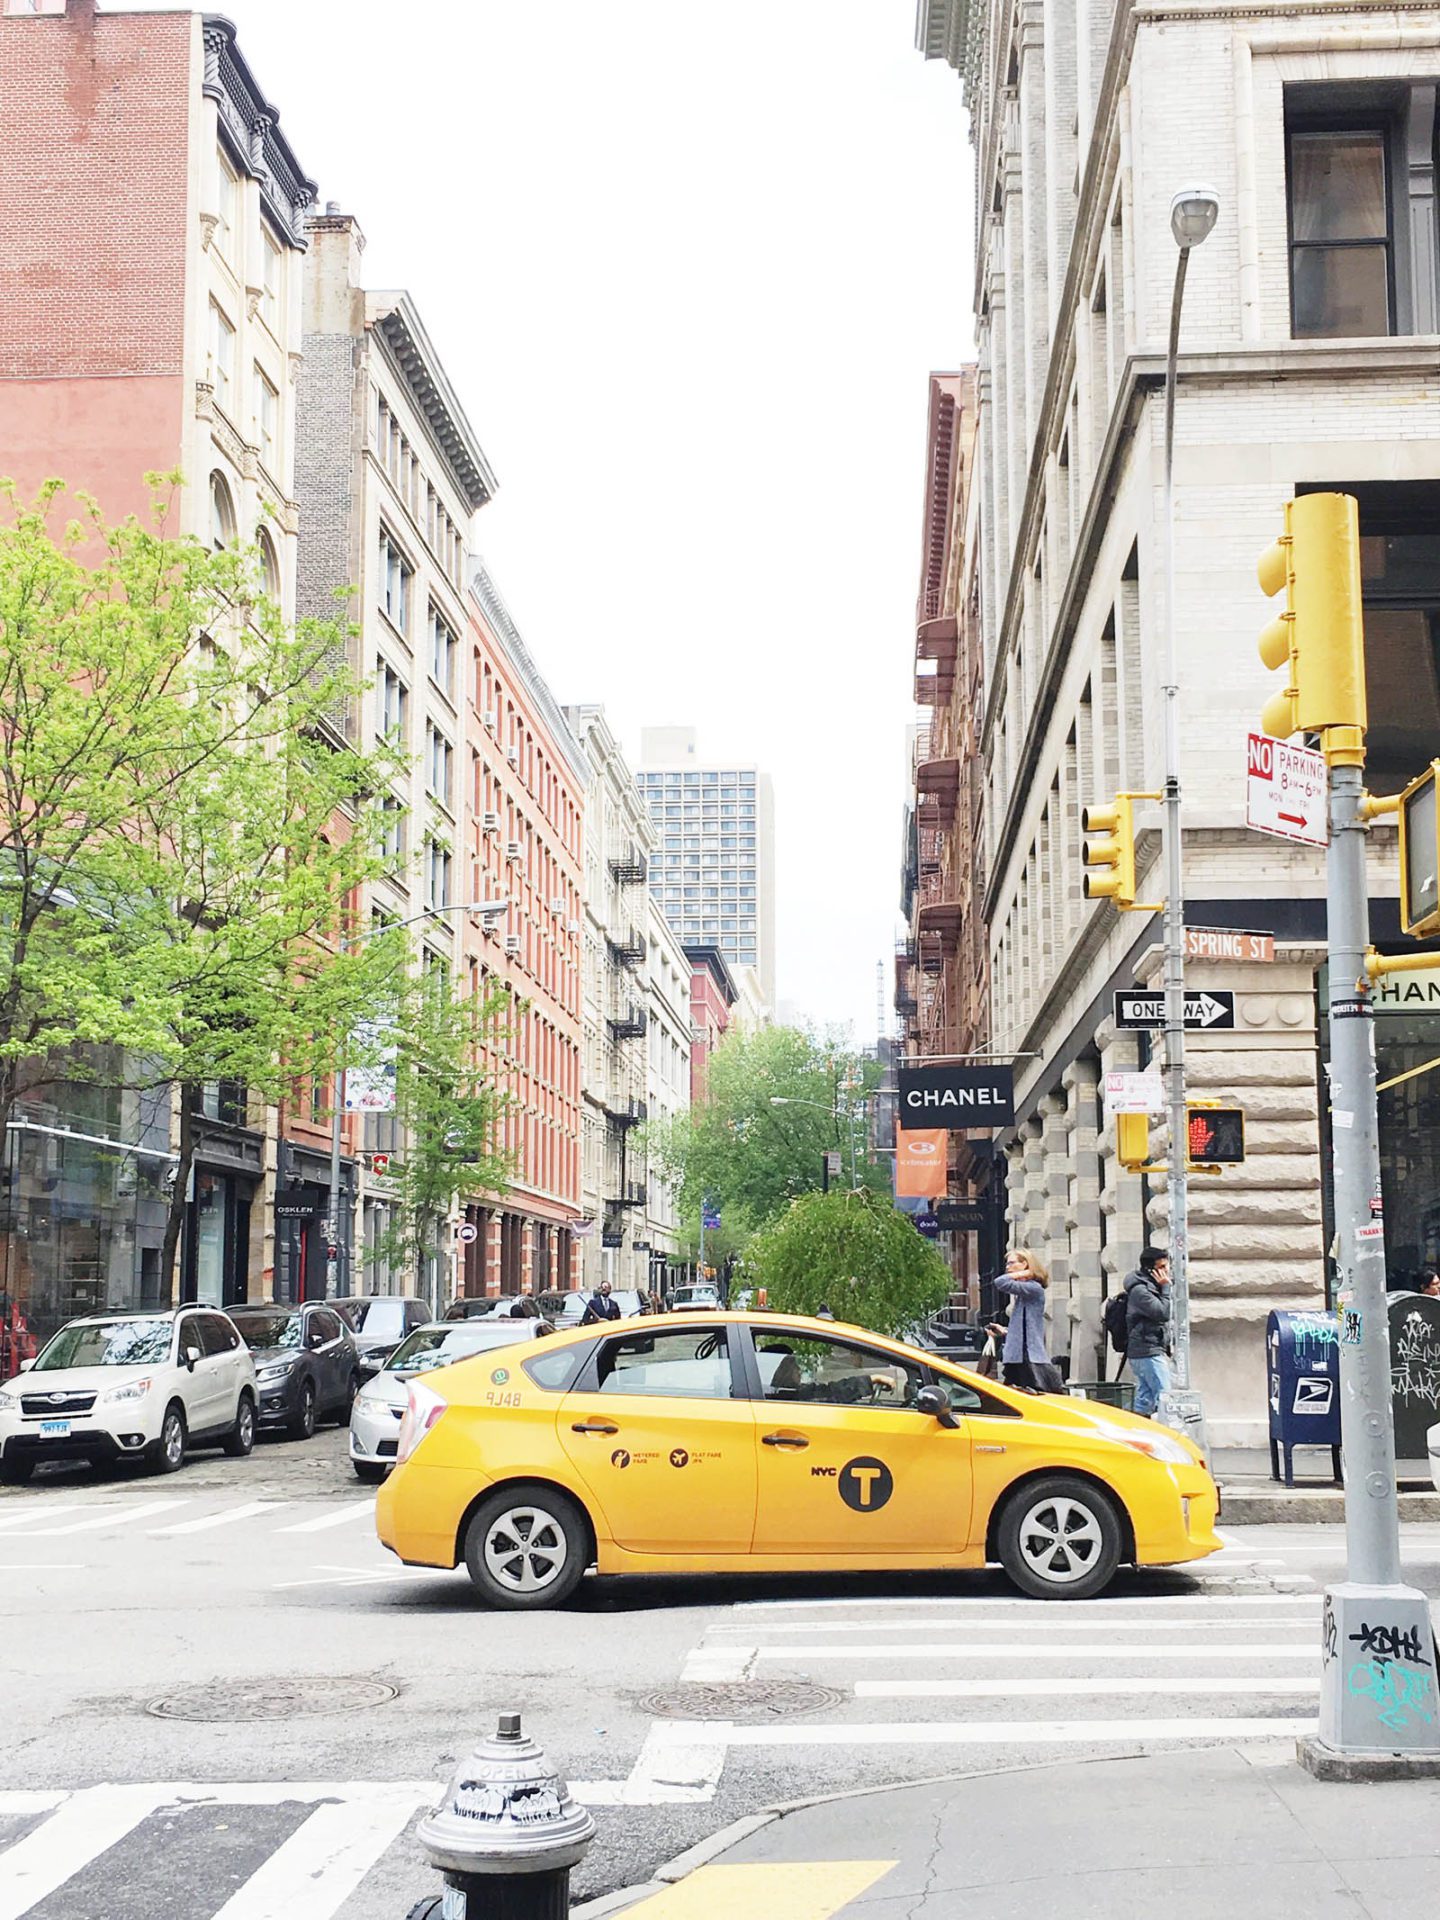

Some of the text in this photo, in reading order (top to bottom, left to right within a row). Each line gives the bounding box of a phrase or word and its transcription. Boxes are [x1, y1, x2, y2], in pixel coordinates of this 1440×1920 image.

[1249, 738, 1324, 780] NO PARKING
[1189, 932, 1268, 958] SPRING ST
[1372, 982, 1440, 1002] HAN
[1132, 1002, 1216, 1017] ONE WAY
[1107, 1076, 1123, 1089] NO
[907, 1088, 1006, 1107] CHANEL
[486, 1391, 521, 1407] 9J48
[811, 1467, 881, 1506] NYC T
